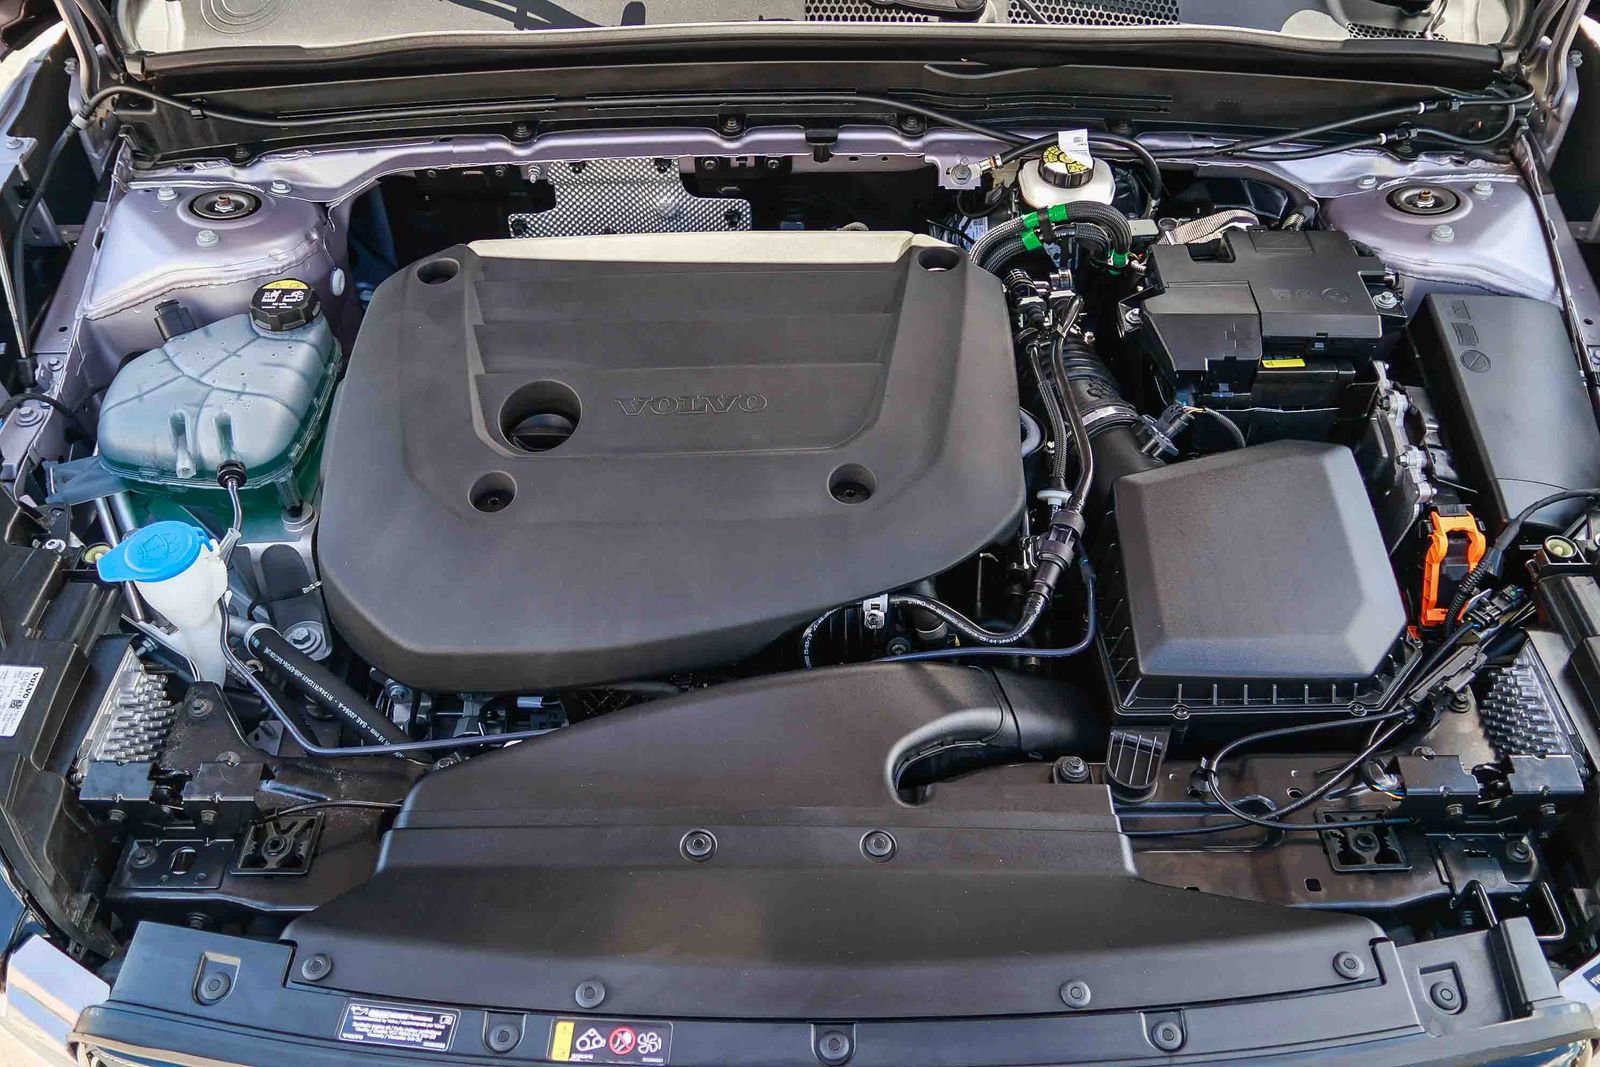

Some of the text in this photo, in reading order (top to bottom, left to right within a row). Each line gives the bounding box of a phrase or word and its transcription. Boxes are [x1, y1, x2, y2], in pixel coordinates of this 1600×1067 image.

[613, 394, 768, 416] VOLVO
[22, 672, 39, 699] VOLVO
[356, 716, 368, 729] SAE
